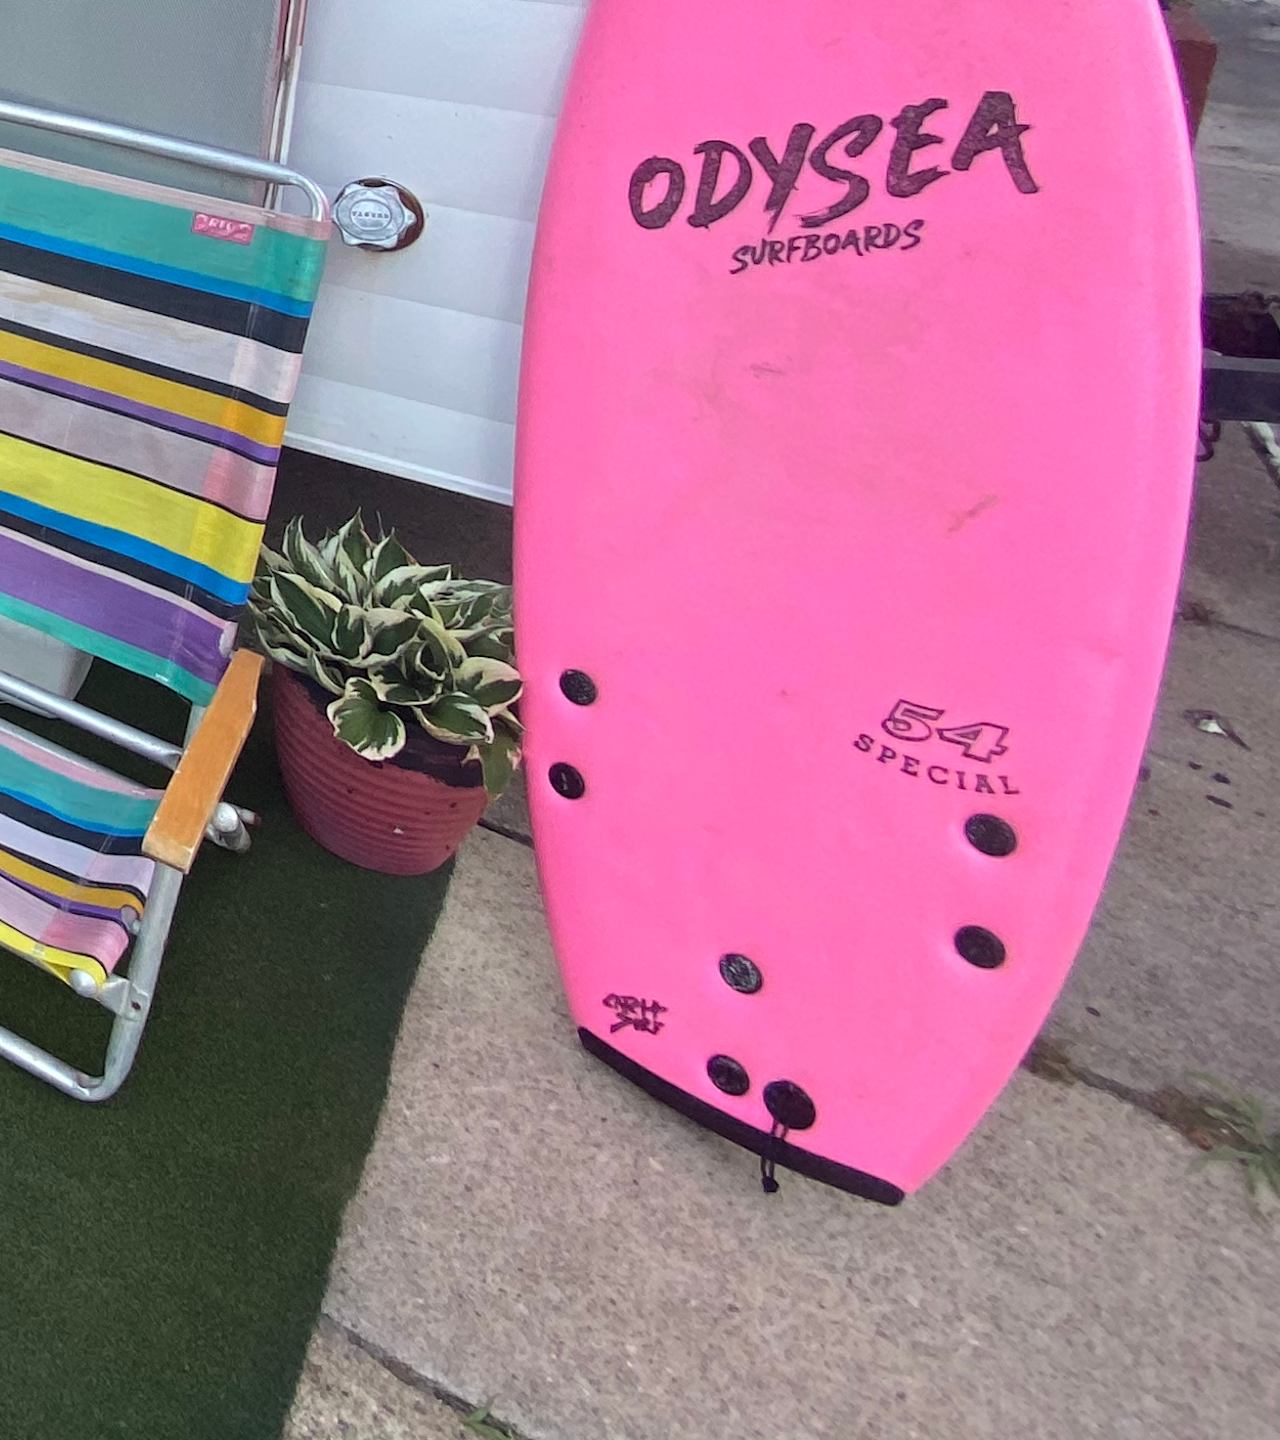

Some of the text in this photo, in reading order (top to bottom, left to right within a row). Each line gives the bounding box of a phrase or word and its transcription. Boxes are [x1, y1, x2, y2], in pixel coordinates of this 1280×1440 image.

[627, 90, 1040, 232] ODYSEA
[729, 218, 926, 275] SURFBOARDS
[880, 699, 1009, 764] 54
[852, 734, 1021, 796] SPECIAL
